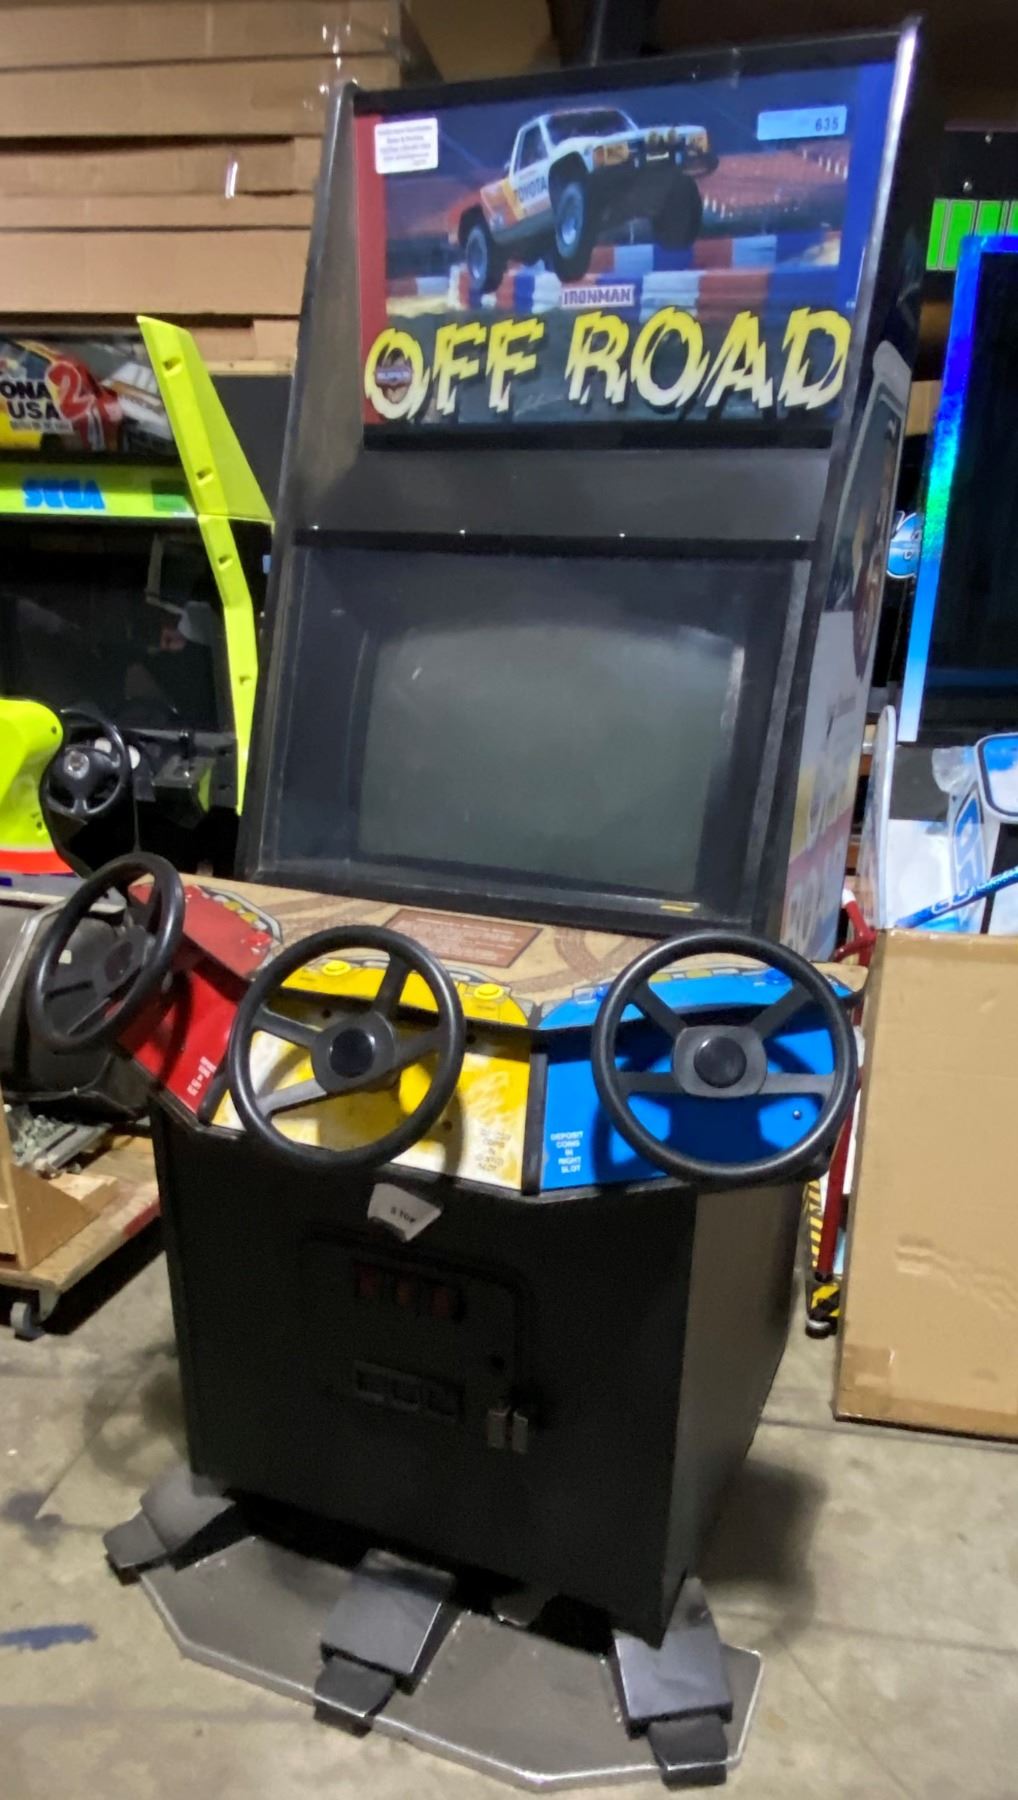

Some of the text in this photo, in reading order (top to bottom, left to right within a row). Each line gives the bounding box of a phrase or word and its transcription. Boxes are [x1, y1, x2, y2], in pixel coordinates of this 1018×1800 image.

[815, 117, 839, 132] 635
[563, 287, 631, 305] IRONMAN
[364, 306, 852, 421] OFF ROAD
[7, 361, 95, 420] USA 2
[22, 477, 106, 511] SEGA
[550, 1131, 584, 1141] DEPOSIT
[560, 1164, 581, 1174] SLOT
